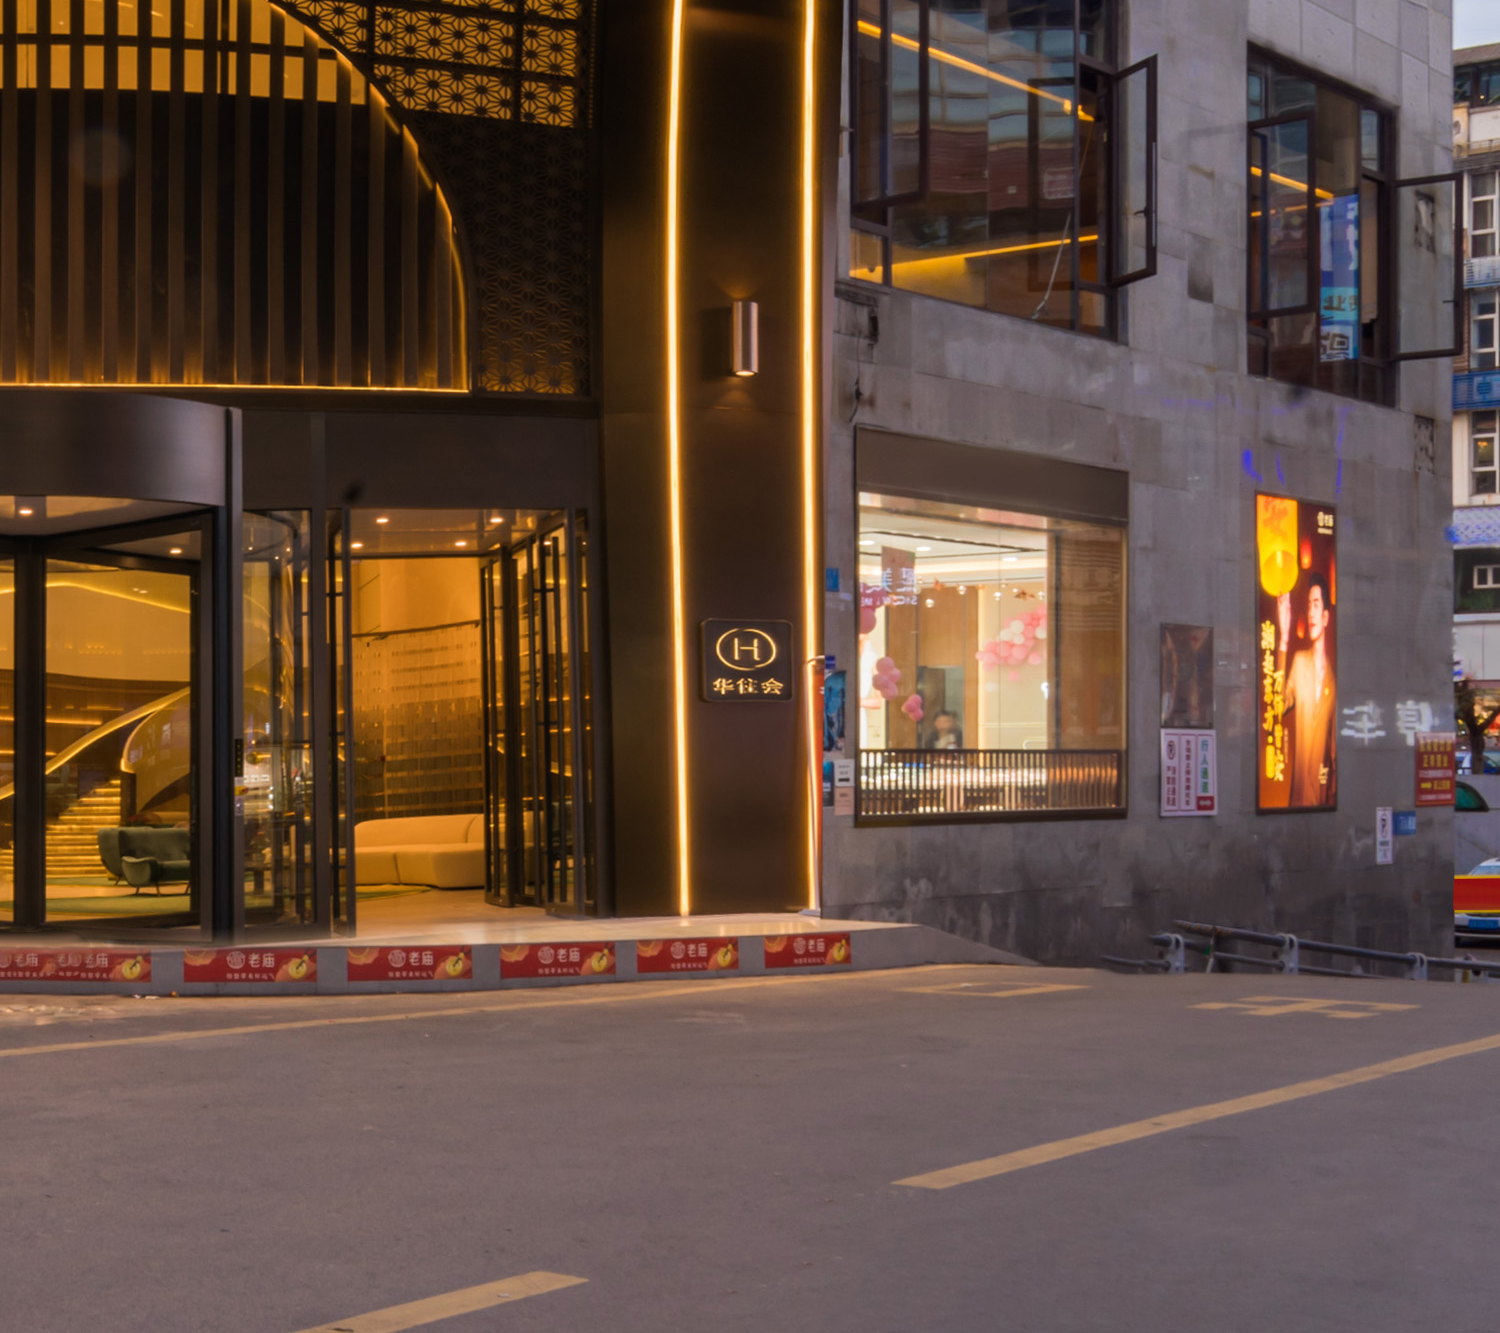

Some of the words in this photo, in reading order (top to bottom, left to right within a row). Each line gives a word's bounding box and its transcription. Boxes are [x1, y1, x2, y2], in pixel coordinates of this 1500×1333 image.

[712, 677, 785, 695] 华住会
[687, 942, 708, 957] 老庙
[807, 938, 825, 952] 老庙
[248, 952, 275, 968] 老庙
[408, 950, 433, 966] 老庙
[557, 947, 580, 962] 老庙
